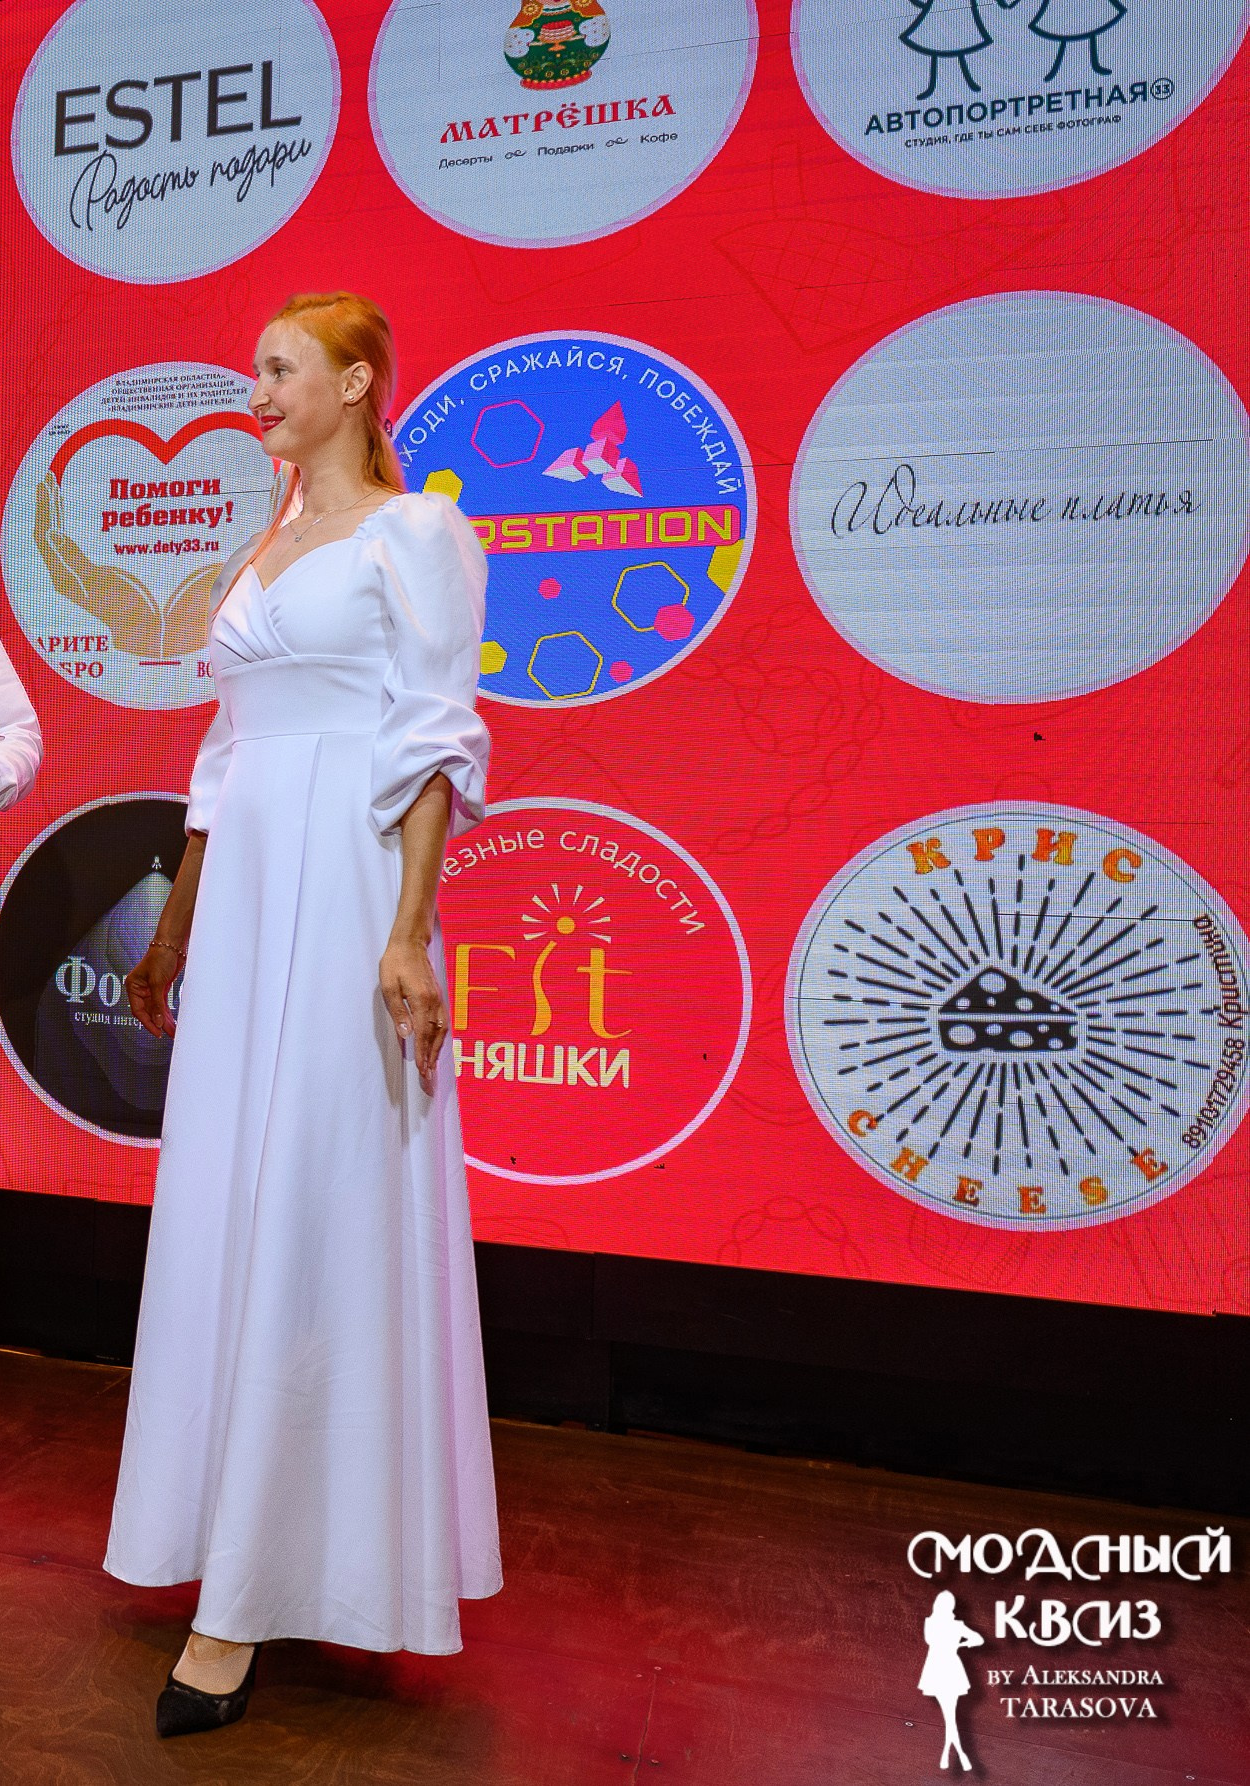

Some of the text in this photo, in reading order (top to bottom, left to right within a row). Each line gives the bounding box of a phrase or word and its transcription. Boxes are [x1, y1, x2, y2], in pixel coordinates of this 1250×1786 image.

[54, 60, 302, 157] ESTEL
[440, 94, 676, 144] МАТРЁШКА
[863, 81, 1148, 135] АВТОПОРТРЕТНАЯ
[904, 114, 1122, 148] СТУДИЯ, ГДЕ ТЫ САМ СЕБЕ ФОТОГРАФ
[438, 131, 679, 170] Десерты Подарки Кофе
[70, 139, 312, 231] Радость подари
[399, 345, 743, 495] ХОДИ, СРАЖАЙСЯ, ПОБЕЖДАЙ
[101, 501, 234, 532] ребенку!
[109, 478, 222, 500] Помоги
[831, 464, 1201, 539] Идеальные платья
[114, 538, 219, 555] www.dety33.ru
[559, 830, 705, 935] сладости
[906, 827, 1143, 883] КРИС
[454, 916, 632, 1039] Fit
[74, 1011, 111, 1025] студия
[849, 1108, 1168, 1214] CHEESE
